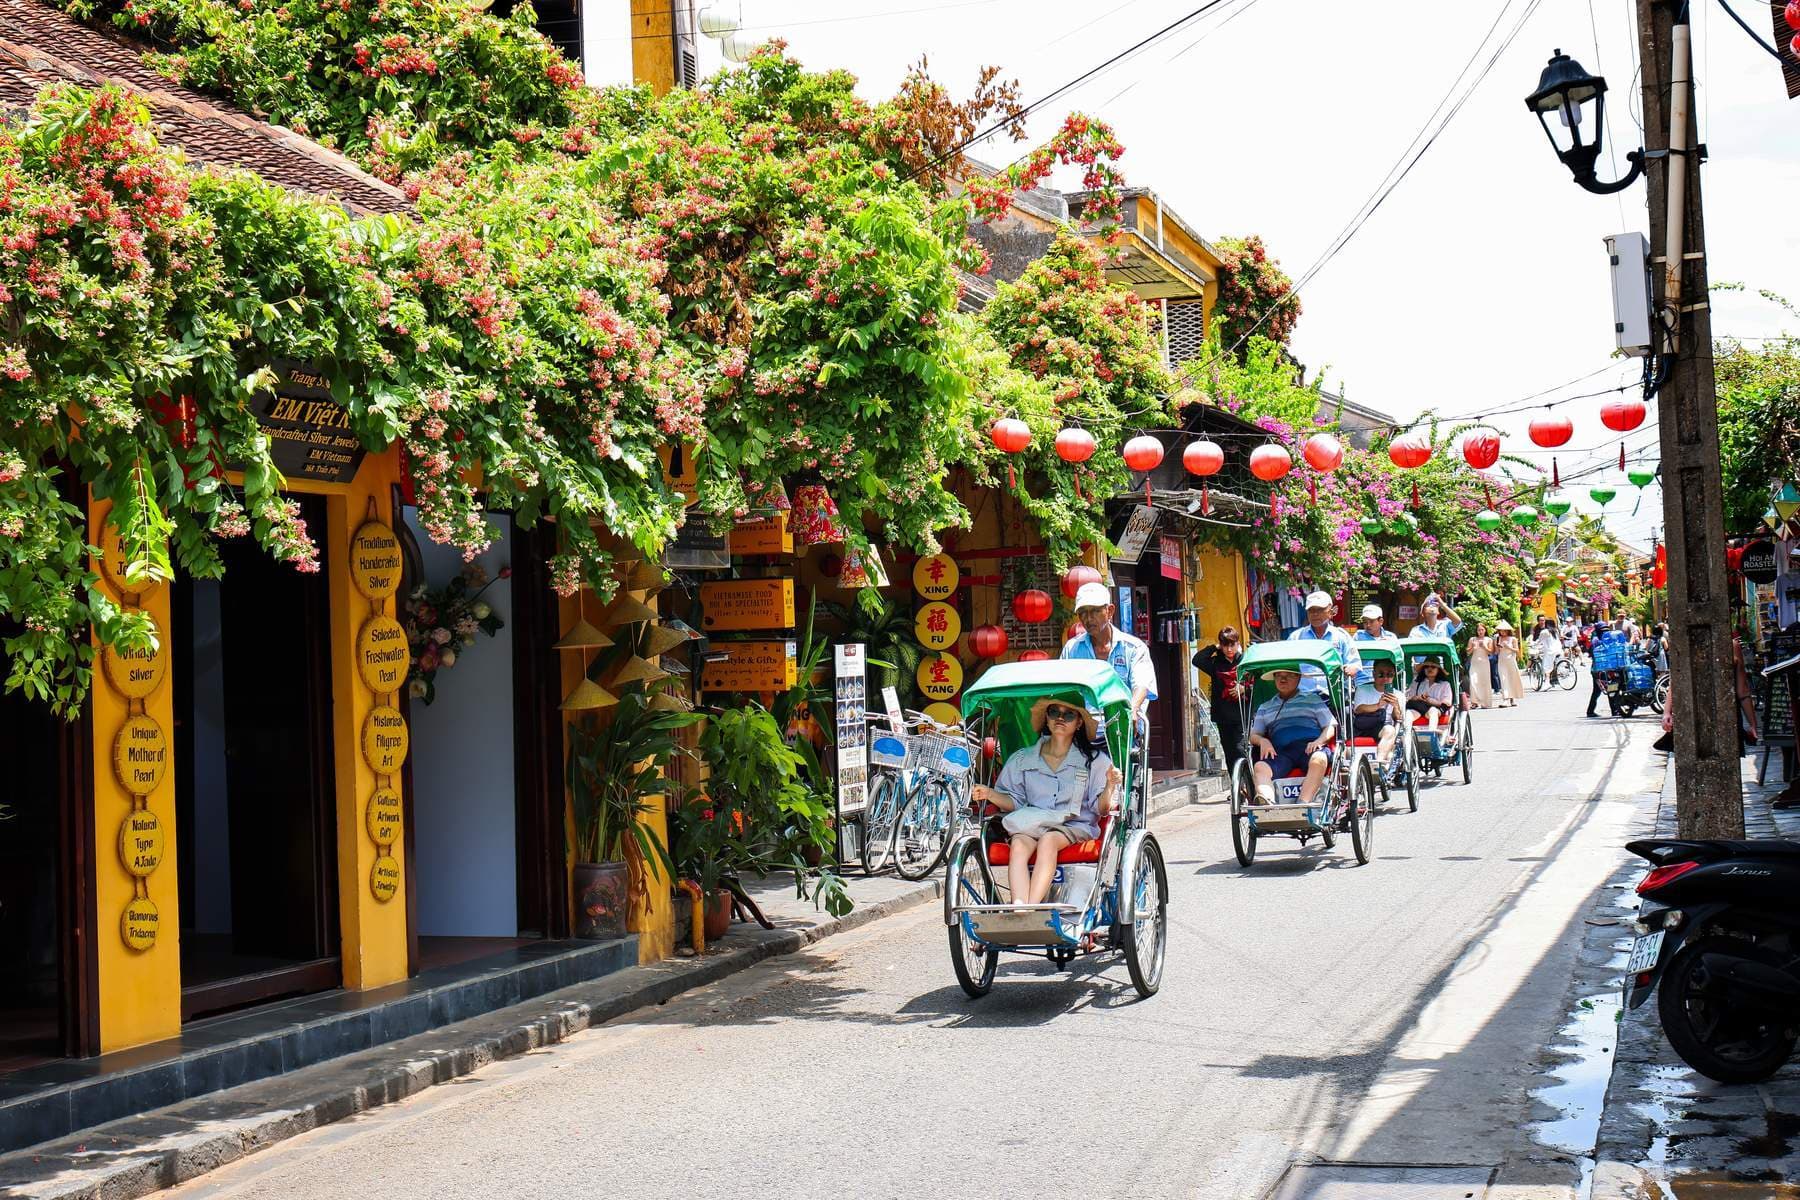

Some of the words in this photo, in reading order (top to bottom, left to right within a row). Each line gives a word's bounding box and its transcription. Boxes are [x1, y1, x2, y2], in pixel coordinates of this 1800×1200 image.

[290, 370, 317, 388] Trang
[270, 398, 308, 421] EM
[304, 400, 339, 430] Việt
[261, 425, 309, 442] Handcrafted
[310, 432, 333, 445] Silver
[310, 449, 322, 460] EM
[357, 536, 395, 550] Traditional
[925, 558, 947, 584] 幸
[369, 576, 391, 589] Silver
[755, 590, 773, 598] FOOD
[925, 585, 949, 594] XING
[927, 608, 949, 633] 福
[371, 628, 400, 642] Selected
[931, 635, 944, 644] FU
[365, 647, 406, 664] Freshwater
[747, 656, 755, 664] &
[756, 656, 777, 665] Gifts
[129, 668, 154, 682] Silver
[378, 668, 397, 682] Pearl
[930, 658, 950, 684] 堂
[926, 685, 954, 694] TANG
[132, 727, 158, 741] Unique
[376, 734, 402, 751] Filigree
[128, 747, 156, 762] Mother
[157, 747, 165, 762] of
[382, 755, 393, 766] Art
[134, 768, 155, 782] Pearl
[1283, 785, 1302, 797] 04
[377, 795, 398, 807] Cultural
[377, 811, 399, 822] Artwork
[132, 819, 157, 831] Natural
[379, 827, 392, 838] Gift
[135, 838, 154, 852] Type
[1720, 866, 1772, 876] Janus
[129, 910, 158, 922] Glamorous
[129, 927, 156, 938] Tridacna
